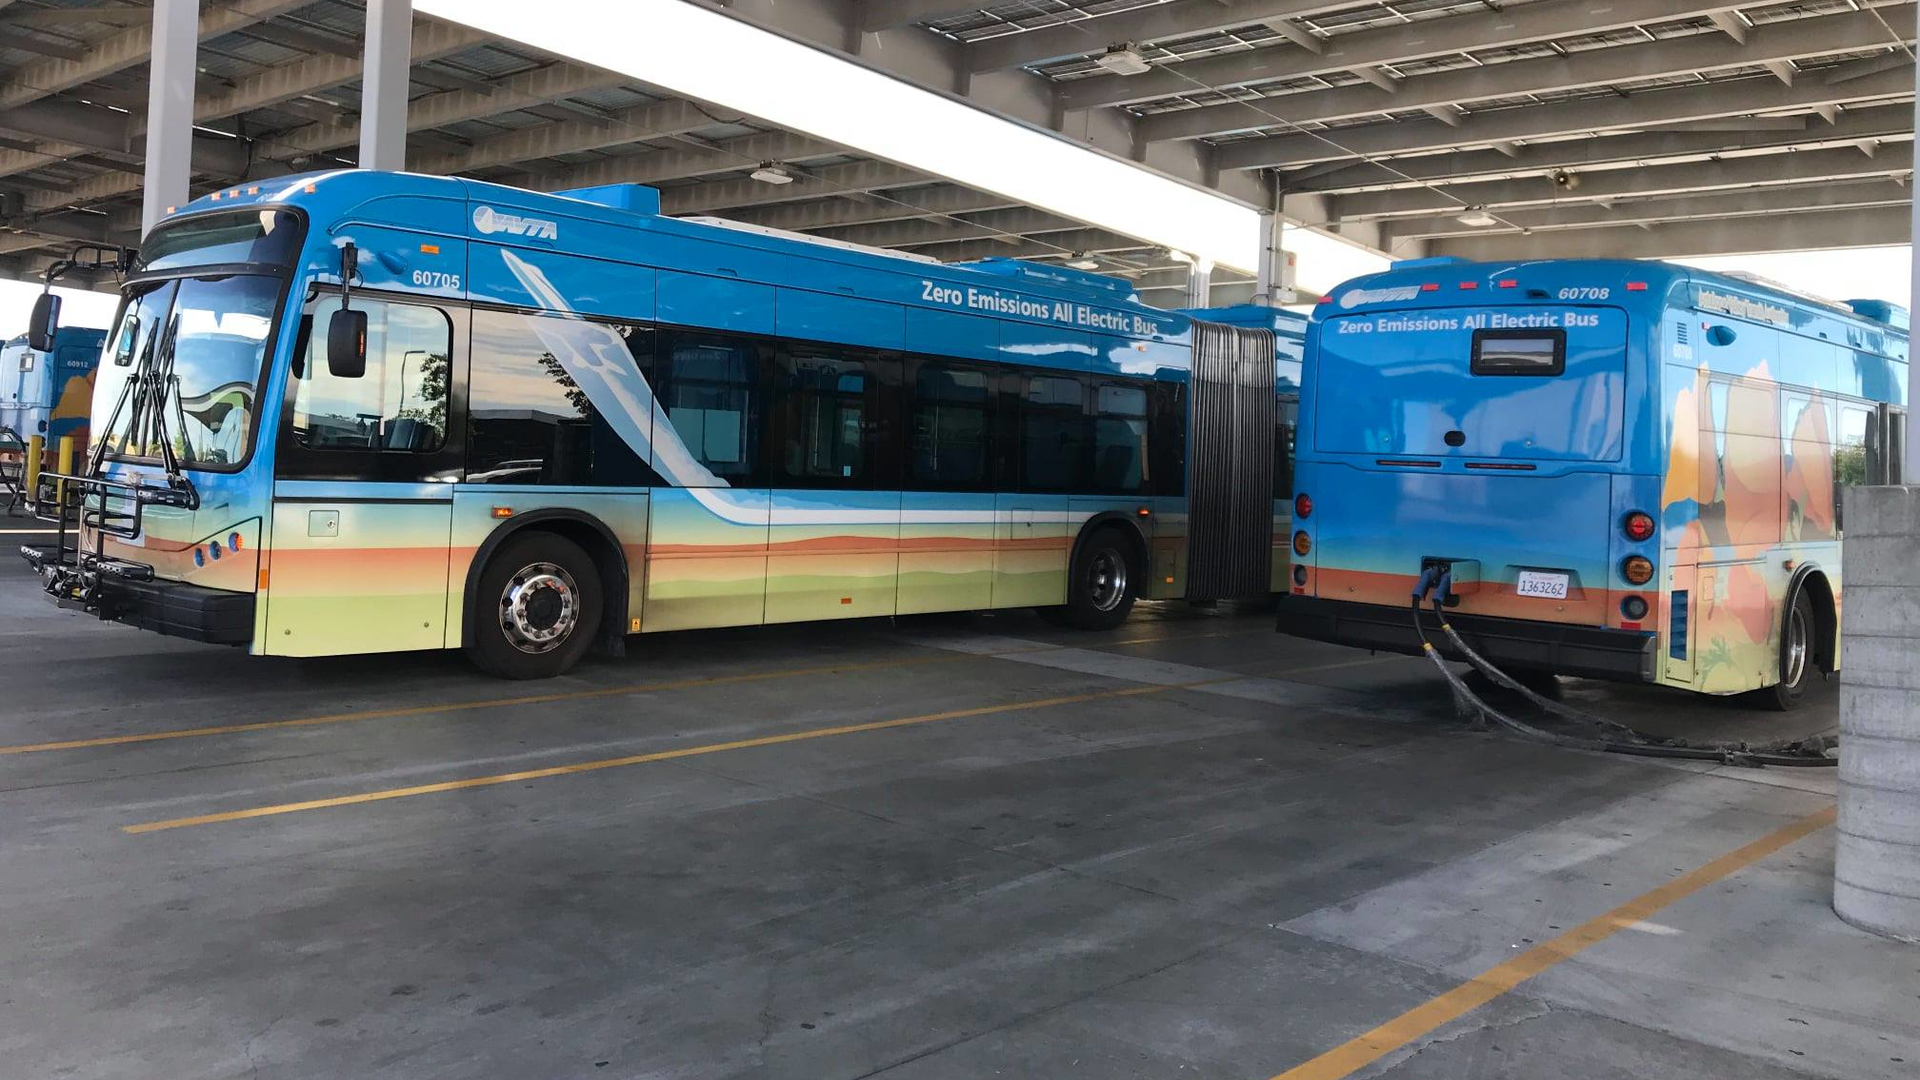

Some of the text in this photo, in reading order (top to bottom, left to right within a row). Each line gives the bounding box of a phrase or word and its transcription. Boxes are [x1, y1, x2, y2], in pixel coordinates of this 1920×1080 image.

[412, 270, 460, 289] 60705
[1558, 287, 1610, 300] 60708
[921, 280, 1158, 336] Zero Emissions All Electric Bus
[1338, 312, 1599, 335] Zero Emissions All Electric Bus
[1520, 580, 1564, 595] 1363262
